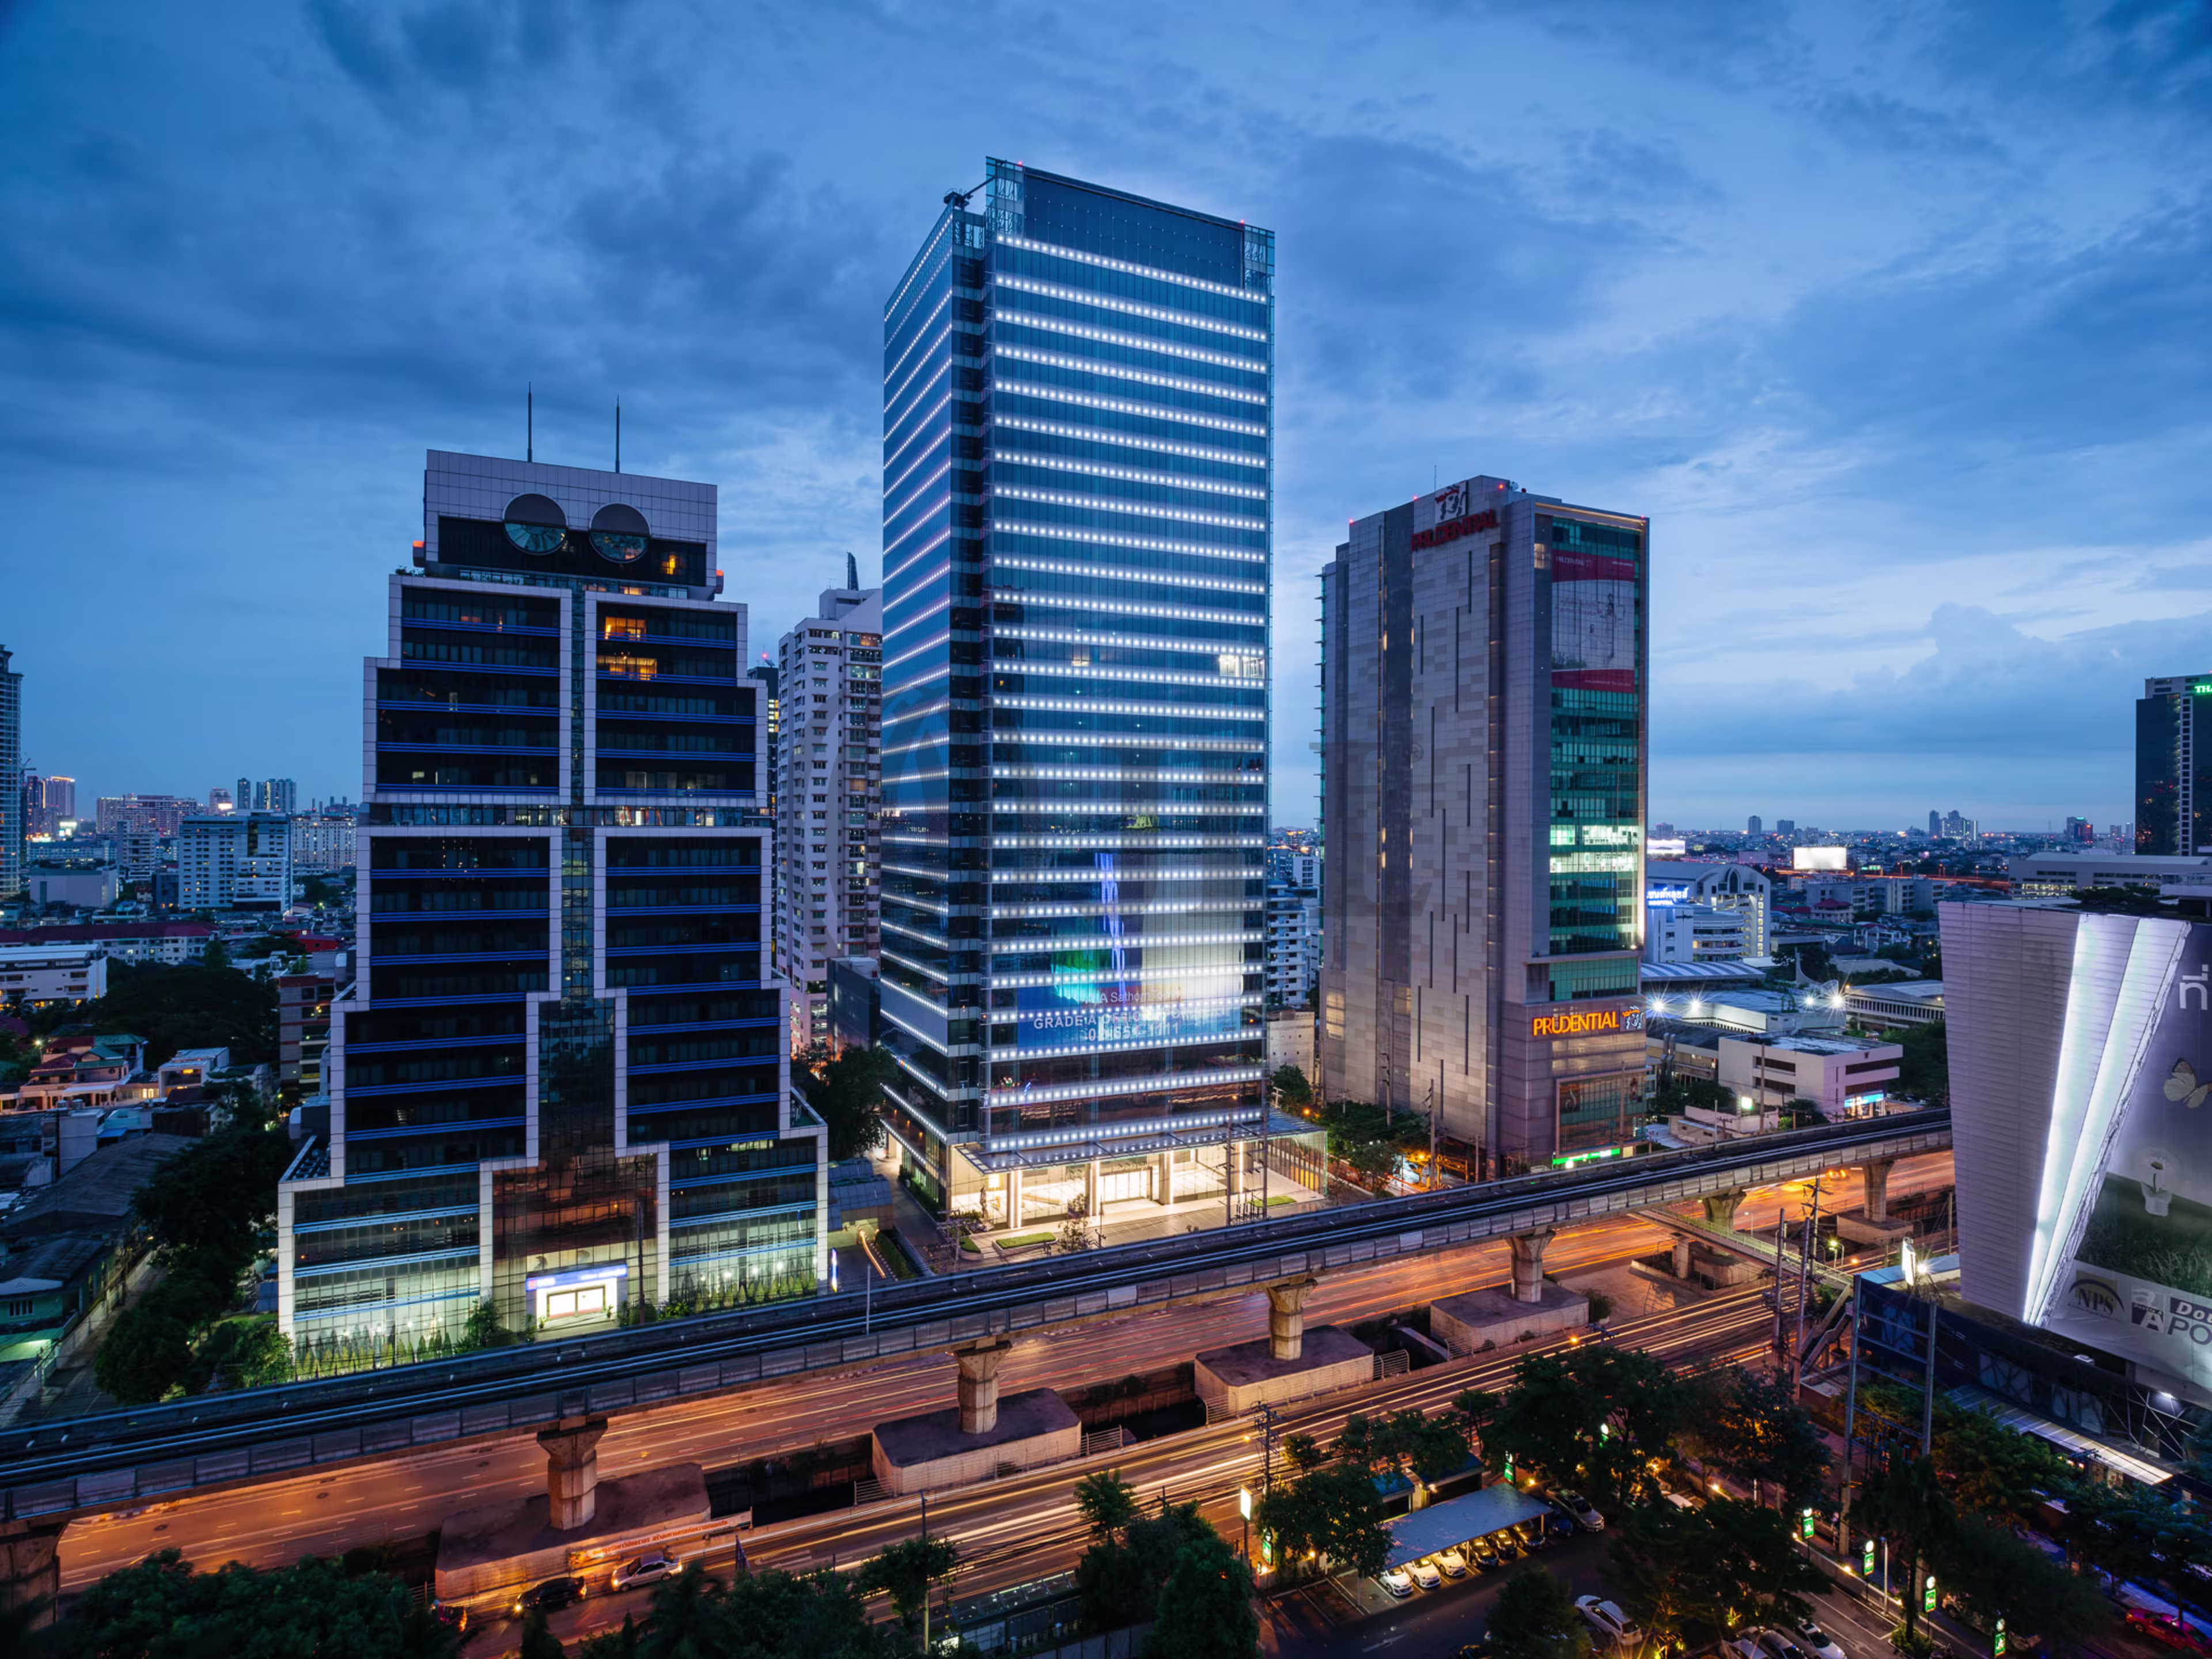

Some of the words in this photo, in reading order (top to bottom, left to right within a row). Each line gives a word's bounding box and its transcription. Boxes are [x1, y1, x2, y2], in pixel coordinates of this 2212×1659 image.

[1410, 509, 1499, 553] PRUDENTIAL
[2194, 685, 2212, 693] TH
[1033, 1015, 1083, 1029] GRADE
[1088, 1014, 1097, 1025] A
[1103, 1010, 1150, 1025] OFFIC
[1533, 1011, 1620, 1036] PRUDENTIAL
[2078, 1287, 2115, 1316] NPS
